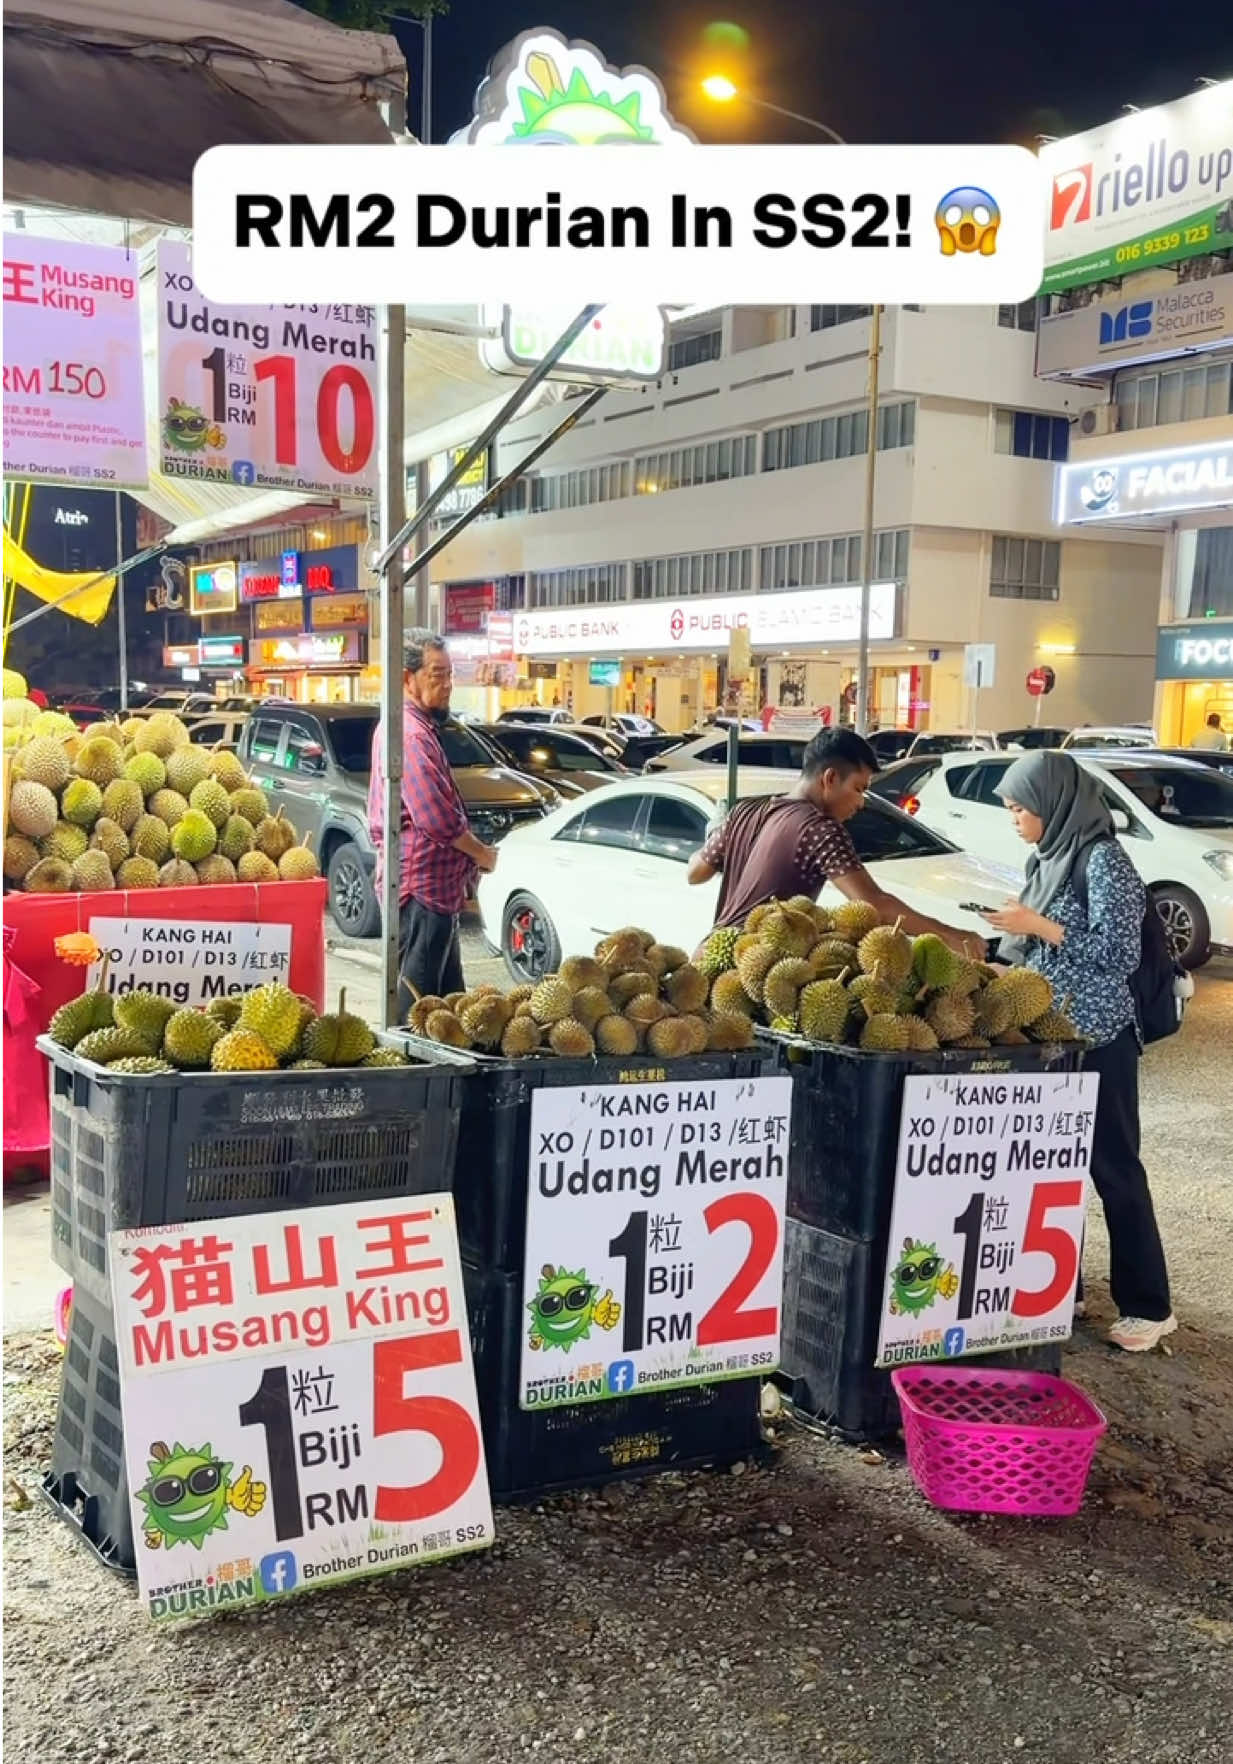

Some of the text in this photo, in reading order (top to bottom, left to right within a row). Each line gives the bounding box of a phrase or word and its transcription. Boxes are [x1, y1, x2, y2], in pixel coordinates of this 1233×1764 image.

[1095, 138, 1189, 217] riello
[1115, 223, 1210, 263] 016 9339 123
[41, 263, 135, 298] Musang
[164, 271, 194, 292] XO
[41, 287, 95, 317] King
[1156, 291, 1215, 314] Malacca
[166, 300, 376, 361] Udang Merah
[1156, 306, 1225, 334] Securities
[48, 360, 106, 399] 150
[228, 382, 257, 402] Biji
[201, 346, 375, 475] 1 10
[227, 406, 257, 426] RM
[29, 462, 67, 476] Durian
[93, 467, 116, 480] SS2
[164, 461, 228, 481] DURIAN
[256, 472, 295, 489] Brother
[297, 477, 331, 491] Durian
[353, 486, 374, 497] SS2
[1127, 456, 1233, 498] FACIAL
[581, 621, 620, 638] BANK
[689, 612, 749, 632] PUBLIC
[142, 927, 232, 945] KANG HAI
[142, 948, 184, 965] D101
[204, 950, 237, 966] D13
[600, 1090, 717, 1118] KANG HAI
[955, 1084, 1042, 1106] KANG HAI
[537, 1131, 575, 1155] XO
[581, 1128, 593, 1157] /
[600, 1126, 654, 1150] D101
[663, 1122, 674, 1151] /
[680, 1121, 722, 1145] D13
[907, 1117, 936, 1138] XO
[939, 1115, 950, 1142] /
[953, 1116, 995, 1137] D101
[1000, 1113, 1010, 1139] /
[1012, 1113, 1045, 1134] D13
[537, 1143, 784, 1199] Udang Merah
[906, 1136, 1088, 1181] Udang Merah
[983, 1195, 1010, 1233] 粒
[649, 1212, 683, 1254] 粒
[131, 1210, 445, 1318] 猫山王
[953, 1180, 1083, 1321] 1 5
[979, 1241, 1016, 1275] Biji
[608, 1190, 778, 1353] 1 2
[648, 1262, 694, 1299] Biji
[974, 1286, 1012, 1316] RM
[132, 1285, 451, 1367] Musang King
[646, 1312, 693, 1346] RM
[966, 1336, 999, 1350] Brother
[1000, 1331, 1030, 1345] Durian
[1049, 1324, 1068, 1337] SS2
[637, 1368, 683, 1384] Brother
[685, 1360, 724, 1377] Durian
[750, 1350, 773, 1366] SS2
[883, 1343, 941, 1363] DURIAN
[292, 1365, 339, 1417] 粒
[525, 1378, 603, 1405] DURIAN
[238, 1328, 481, 1543] 1 5
[299, 1423, 362, 1470] Biji
[306, 1484, 369, 1531] RM
[302, 1555, 364, 1580] Brother
[367, 1542, 419, 1565] Durian
[455, 1524, 486, 1543] SS2
[148, 1578, 203, 1598] BROTHER
[149, 1576, 255, 1619] DURIAN
